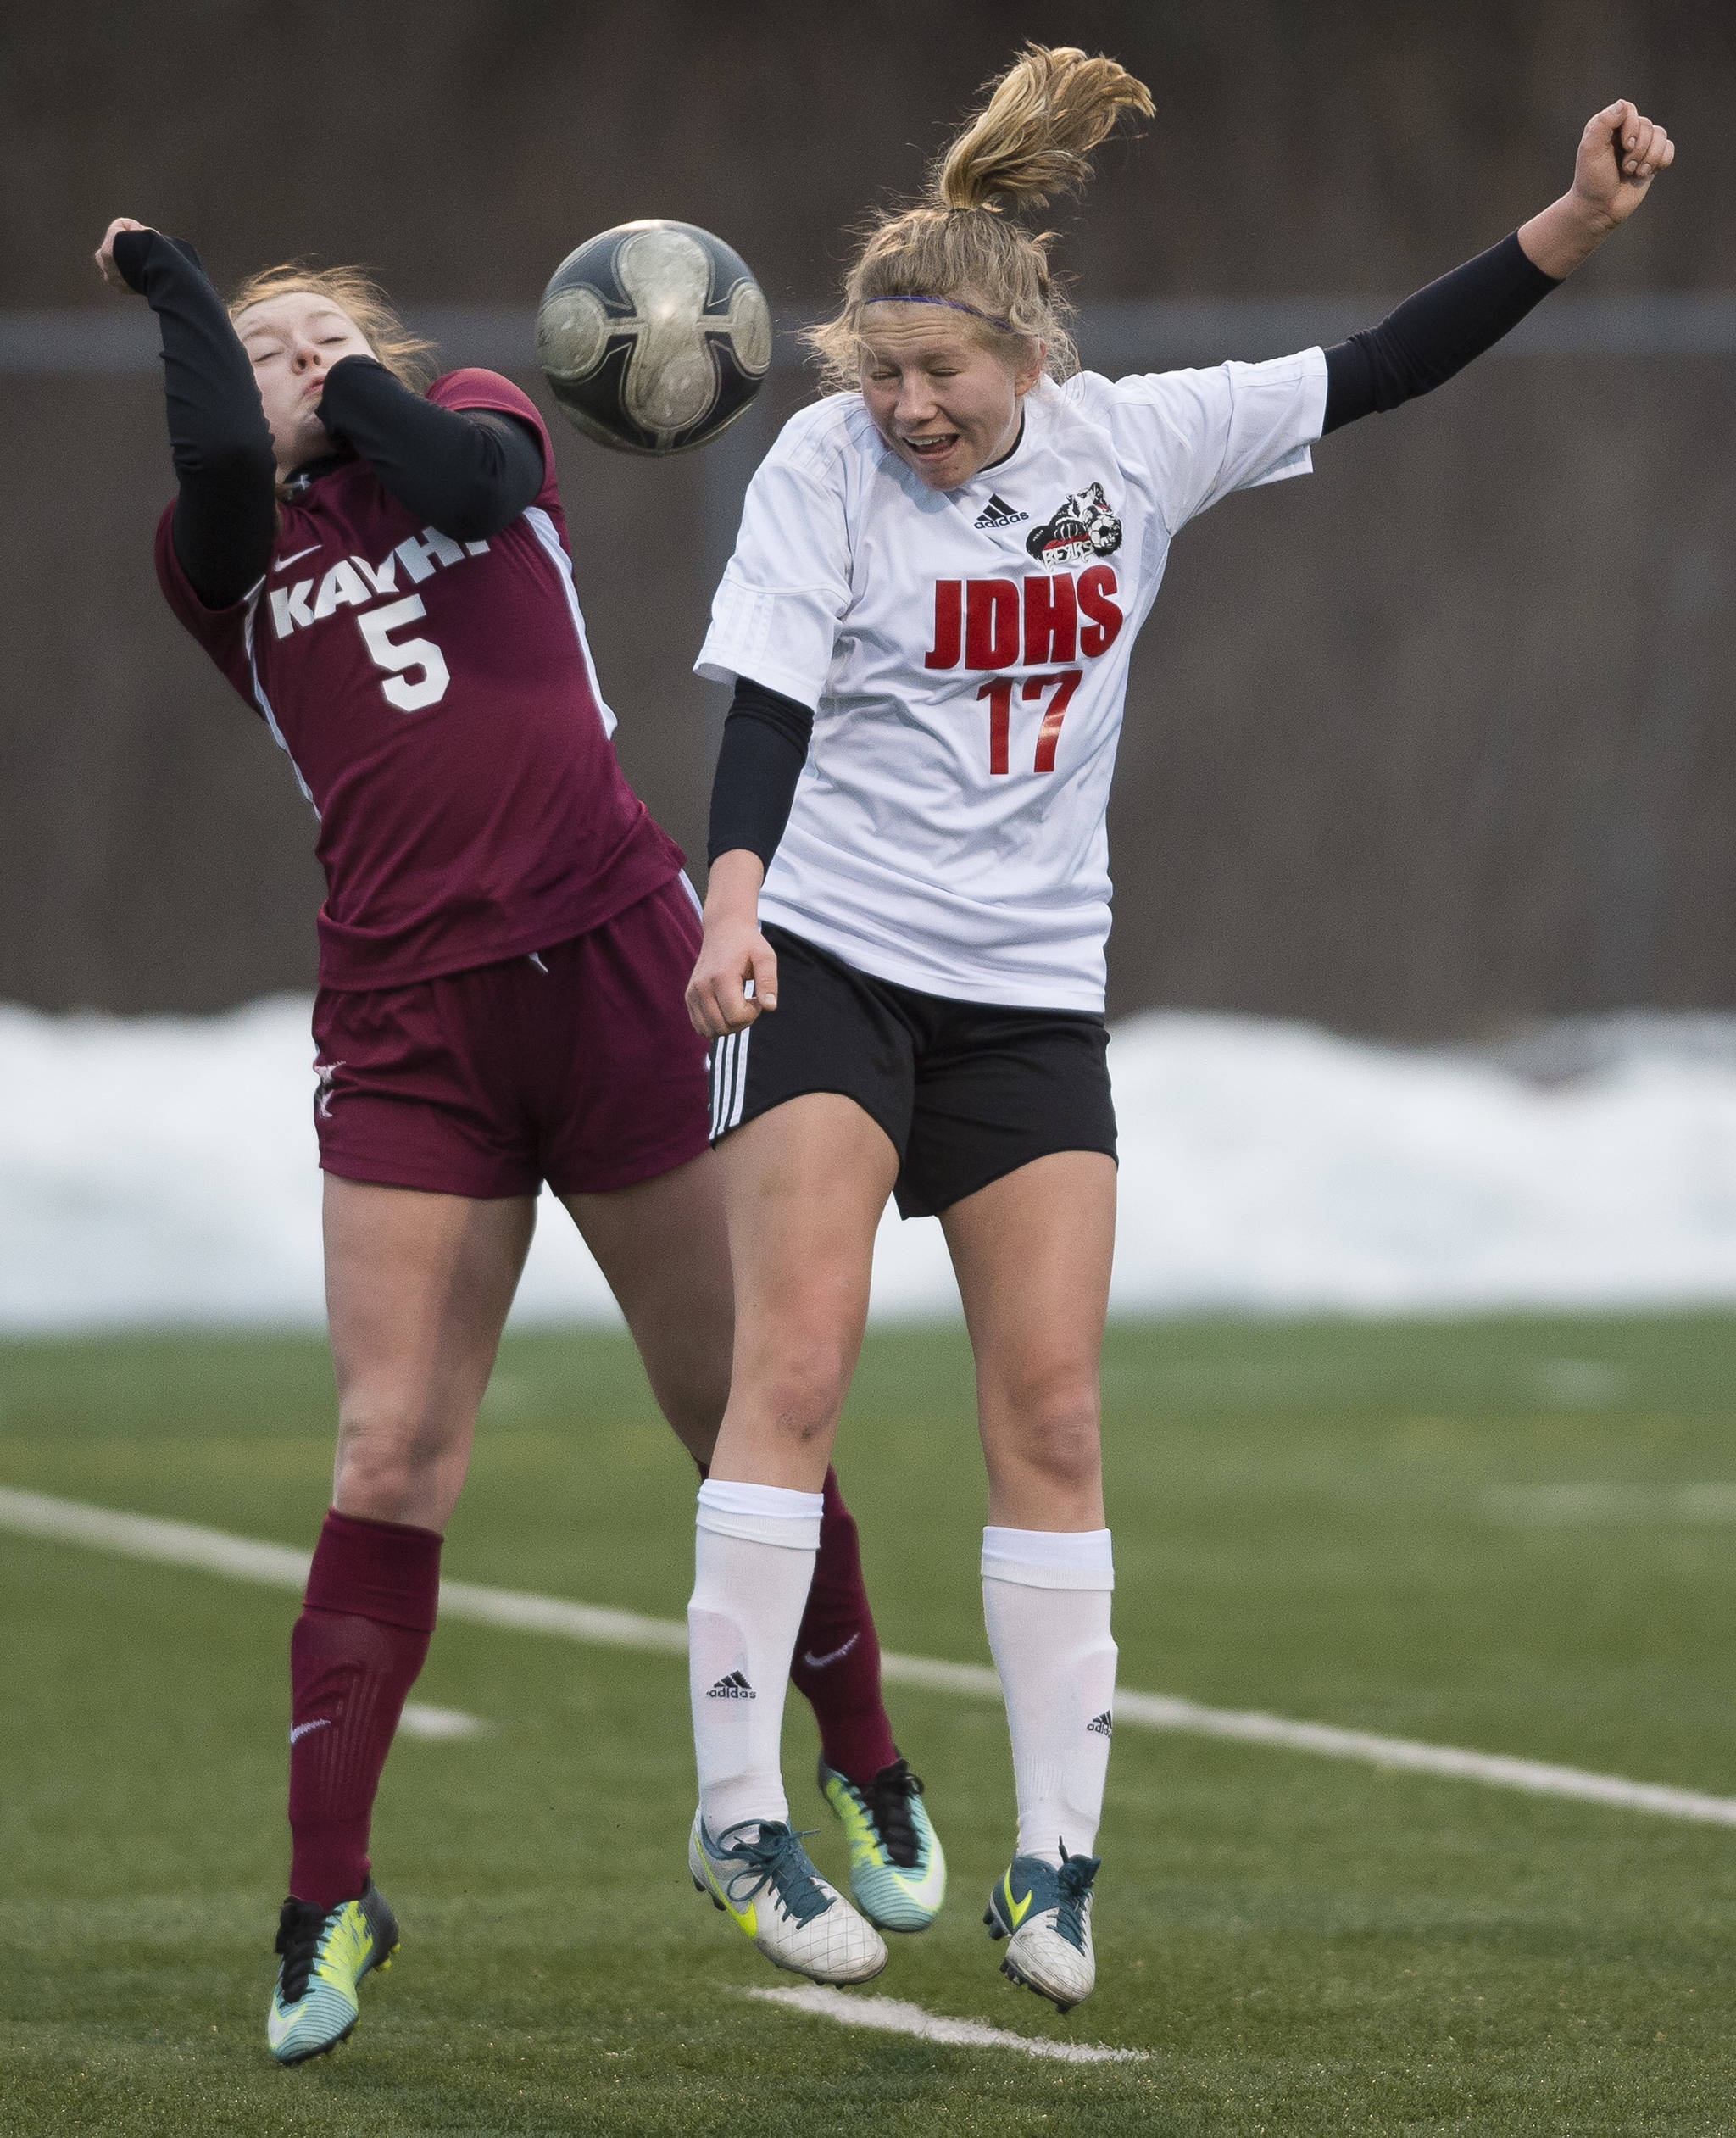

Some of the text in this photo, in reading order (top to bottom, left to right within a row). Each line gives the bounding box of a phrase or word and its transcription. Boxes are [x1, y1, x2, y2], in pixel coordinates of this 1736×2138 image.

[974, 510, 1030, 530] adidas
[1042, 540, 1094, 571] BEARS
[270, 526, 490, 639] KAYH
[925, 565, 1123, 671] JDHS
[357, 593, 450, 712] 5
[976, 669, 1083, 775] 17
[706, 1687, 756, 1698] adidas
